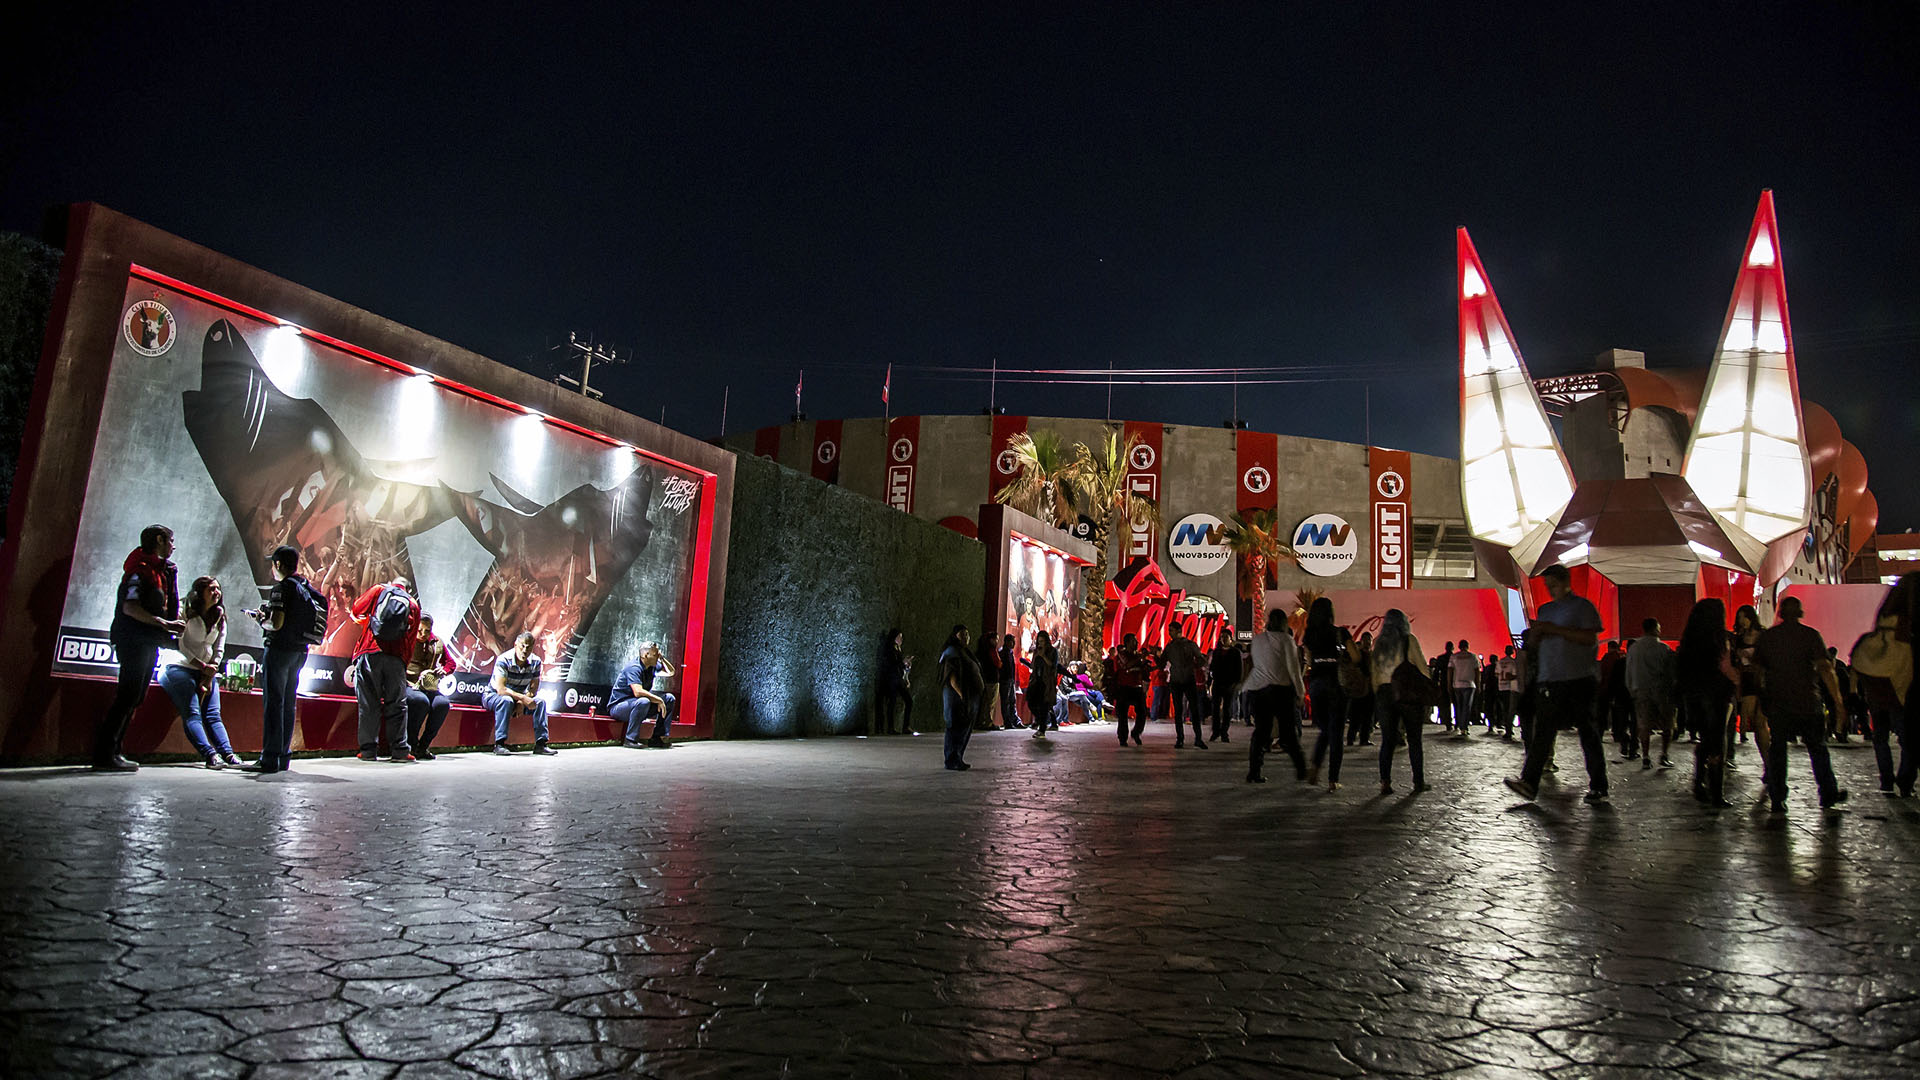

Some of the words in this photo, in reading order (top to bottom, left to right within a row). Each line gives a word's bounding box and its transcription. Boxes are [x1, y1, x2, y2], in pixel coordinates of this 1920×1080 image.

[131, 301, 149, 313] CLUB
[150, 302, 174, 325] TIJUANA
[1381, 507, 1402, 588] LIGHT
[63, 641, 112, 661] BUD
[579, 694, 602, 704] xolotv
